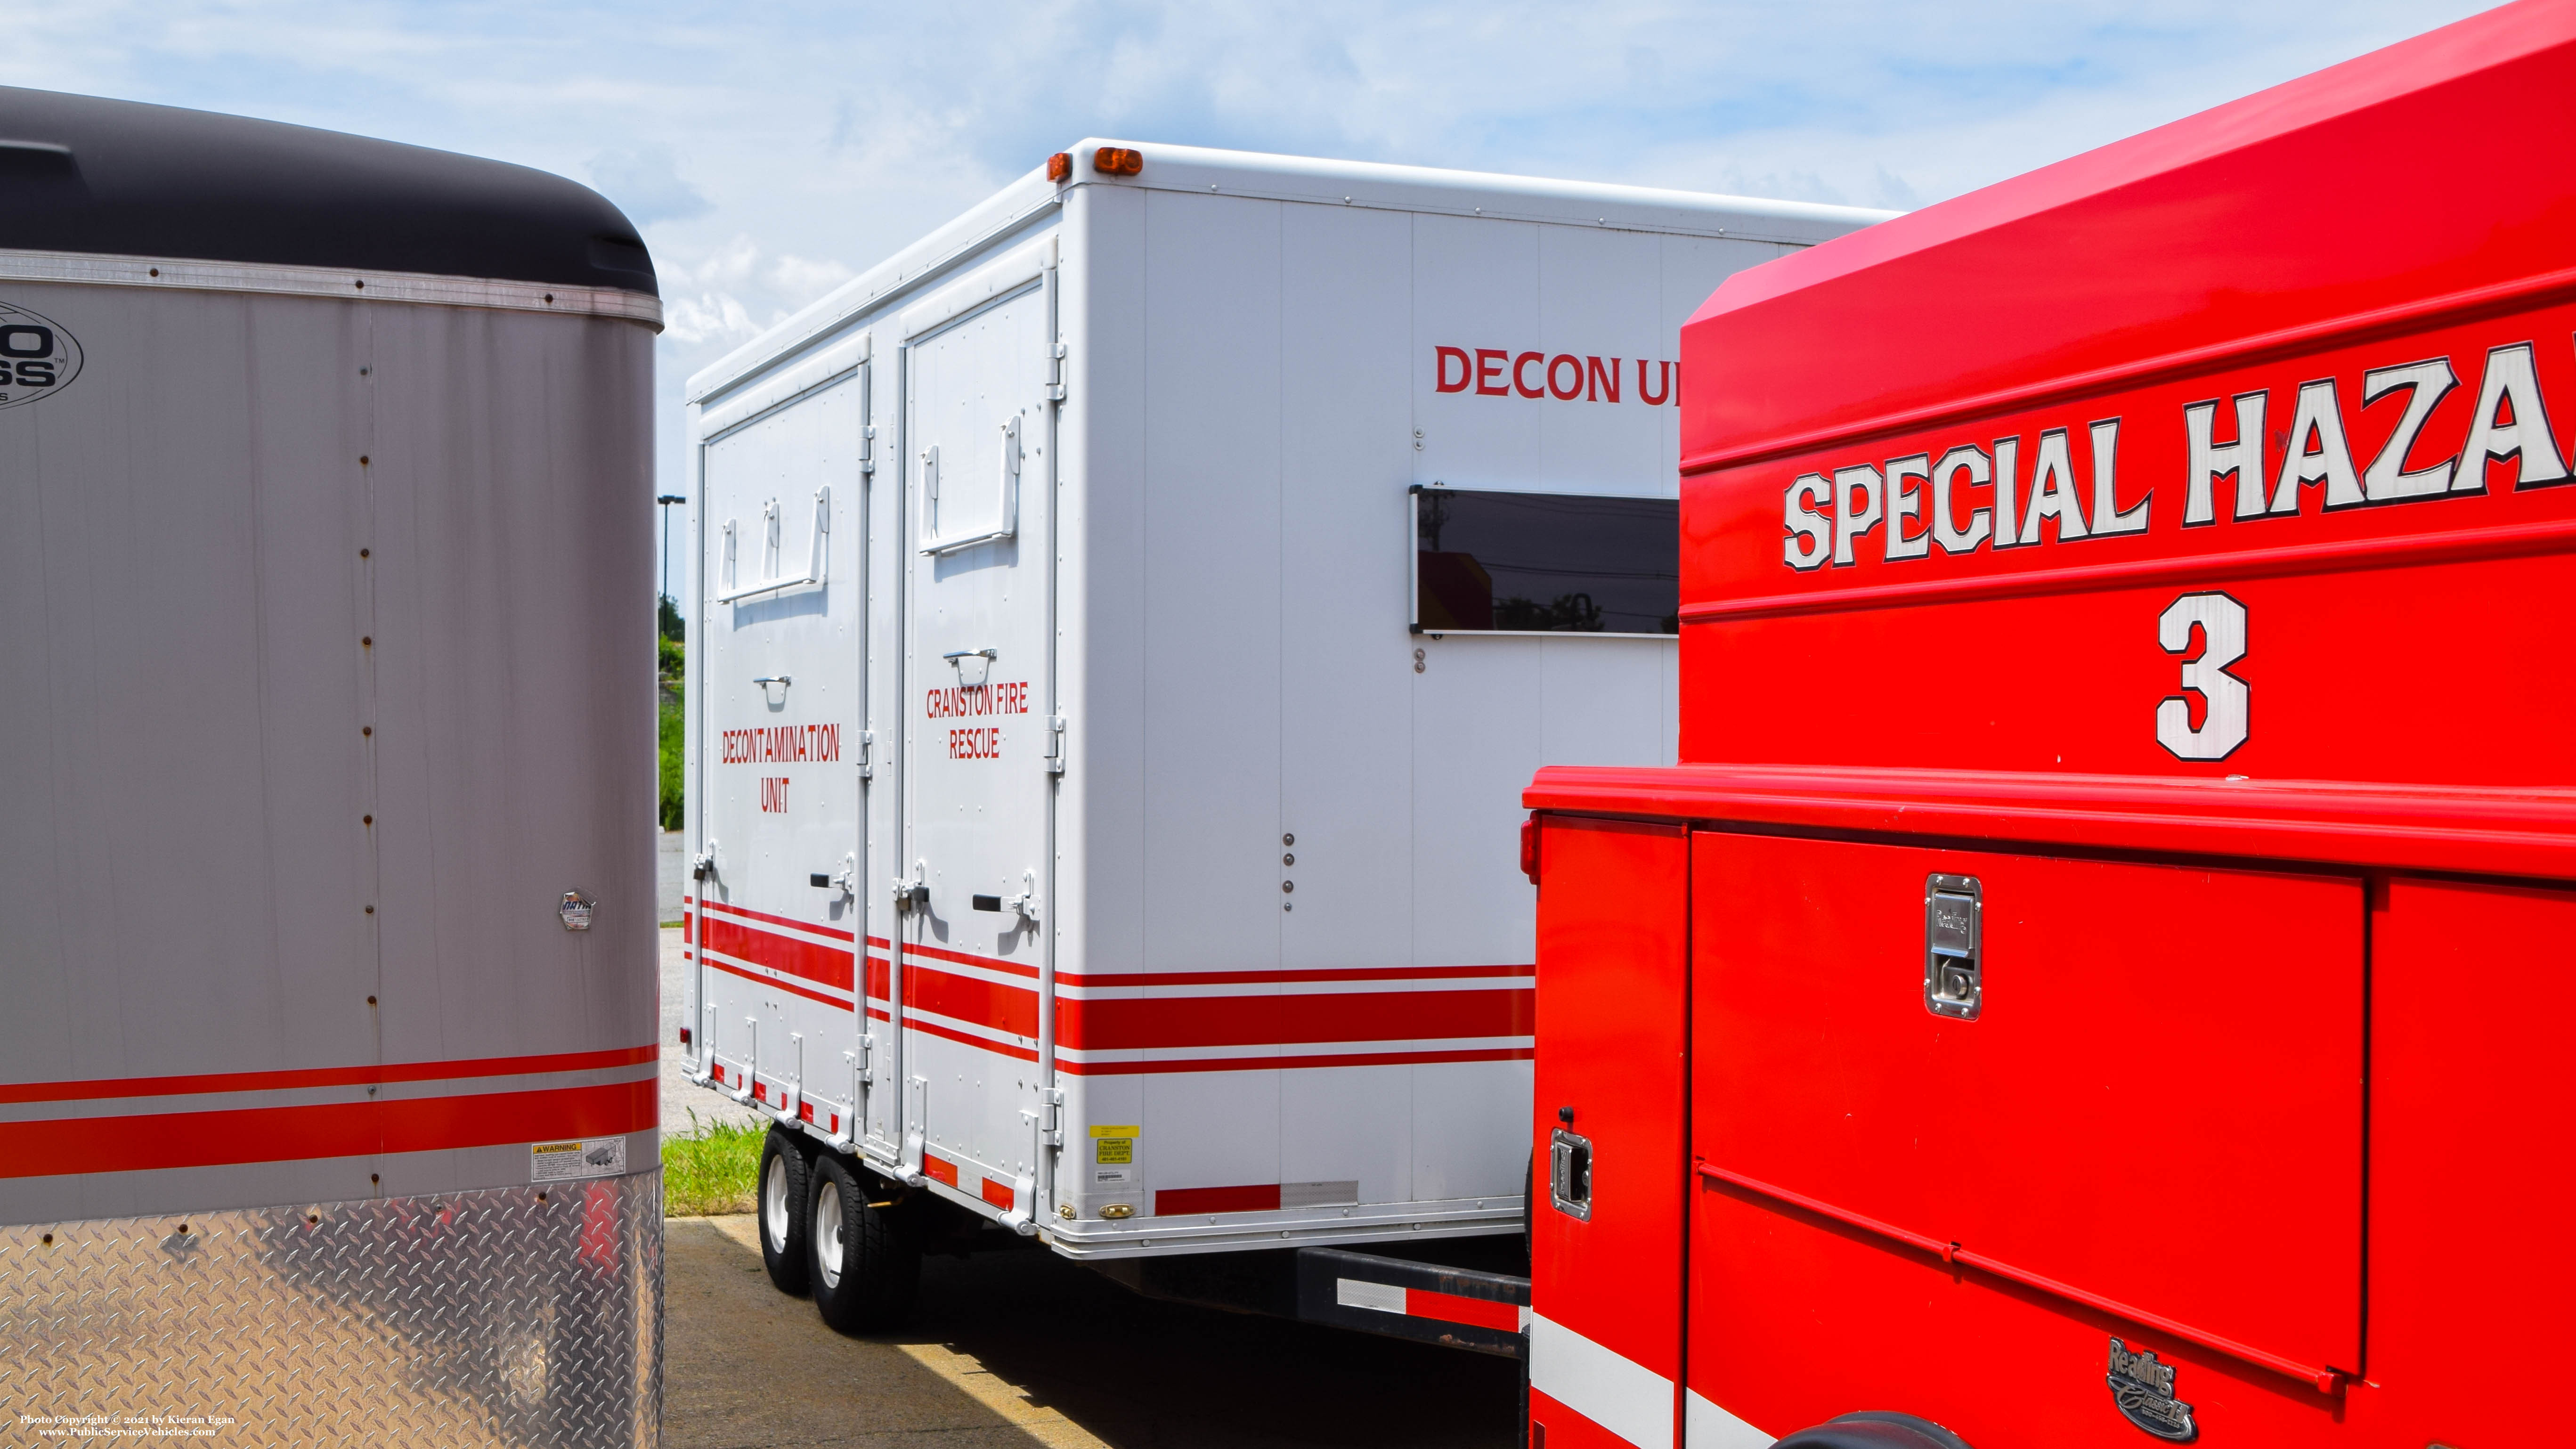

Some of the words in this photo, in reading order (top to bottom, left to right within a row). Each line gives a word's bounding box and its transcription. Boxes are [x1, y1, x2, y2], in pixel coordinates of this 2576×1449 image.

[1434, 345, 1622, 403] DECON
[1782, 416, 2154, 573] SPECIAL
[2181, 331, 2576, 529] HAZA
[2155, 590, 2251, 763] 3
[926, 684, 994, 719] CRANSTON
[996, 681, 1029, 715] FIRE
[722, 723, 841, 764] DECONTAMINATION
[949, 727, 1000, 759] RESCUE
[761, 777, 789, 814] UNIT
[543, 1144, 577, 1152] WARNING
[2110, 1338, 2174, 1397] Reading
[2109, 1376, 2171, 1414] Classic
